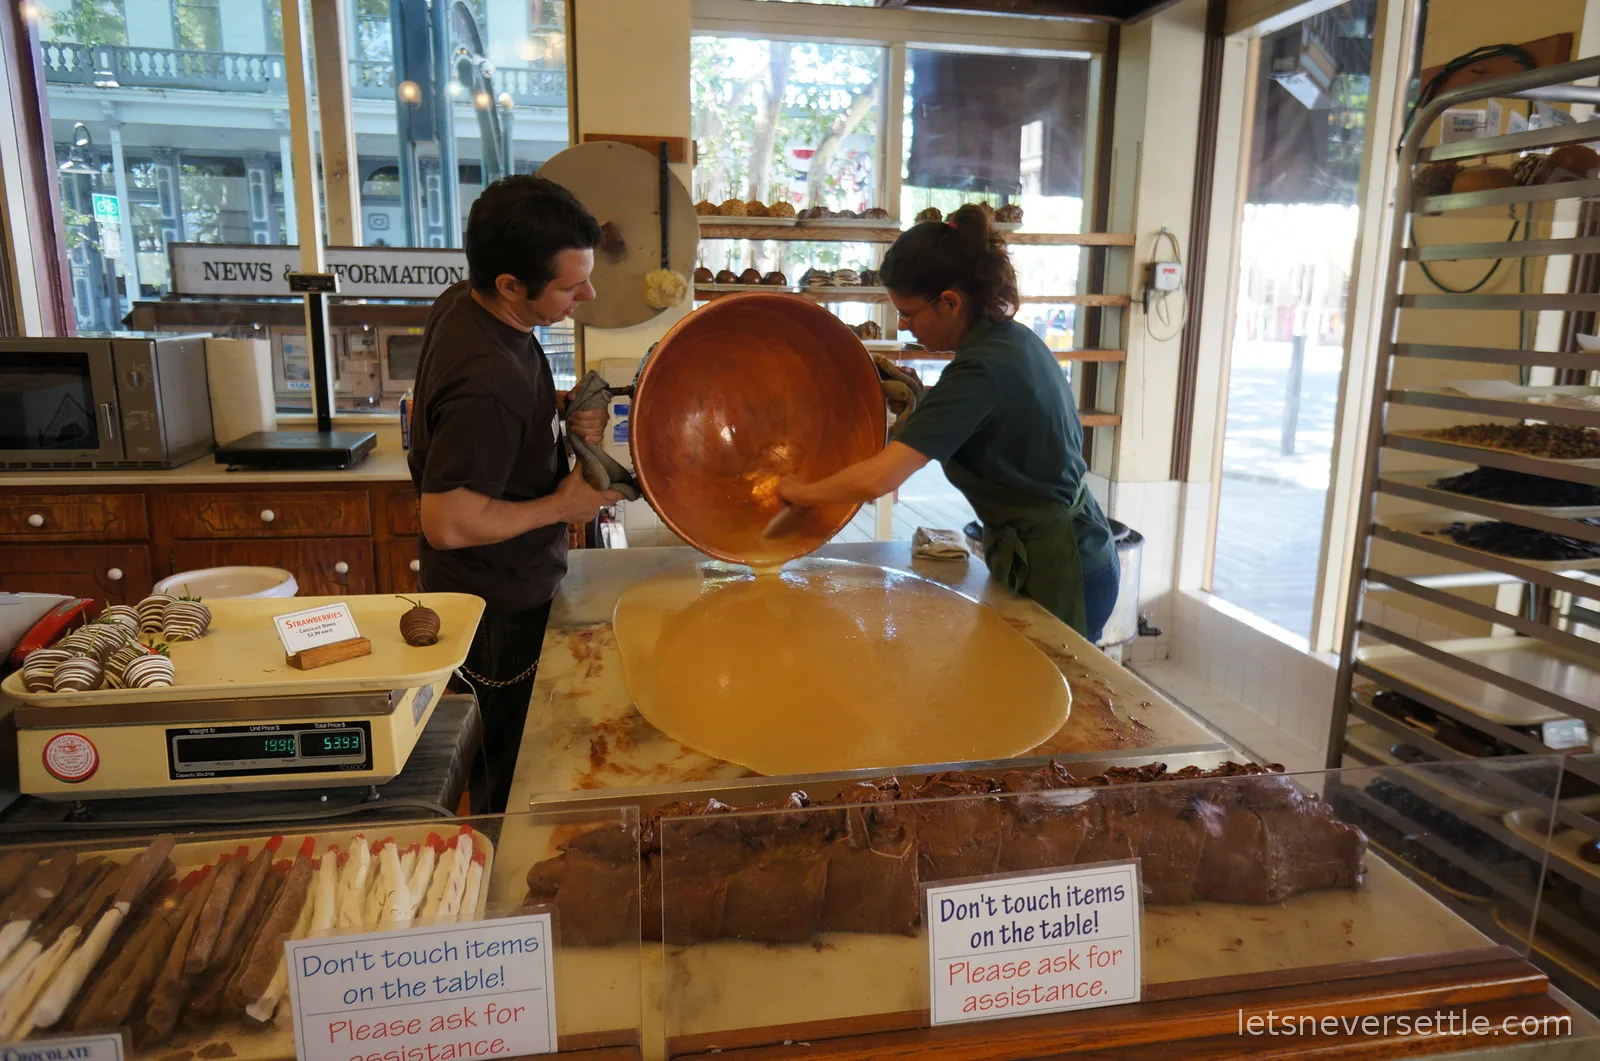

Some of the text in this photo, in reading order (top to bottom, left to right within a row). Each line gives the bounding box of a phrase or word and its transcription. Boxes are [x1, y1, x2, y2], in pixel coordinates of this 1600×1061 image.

[203, 262, 273, 282] NEWS
[326, 264, 464, 285] FORMATION
[286, 611, 342, 629] STRAWBERRIES
[940, 884, 1125, 923] Don't touch items
[970, 910, 1099, 949] on the table!
[302, 936, 539, 978] Don't touch items
[949, 945, 1123, 986] Please ask for
[343, 965, 505, 1005] on the table!
[962, 979, 1108, 1013] assistance.
[327, 1002, 525, 1043] Please ask for
